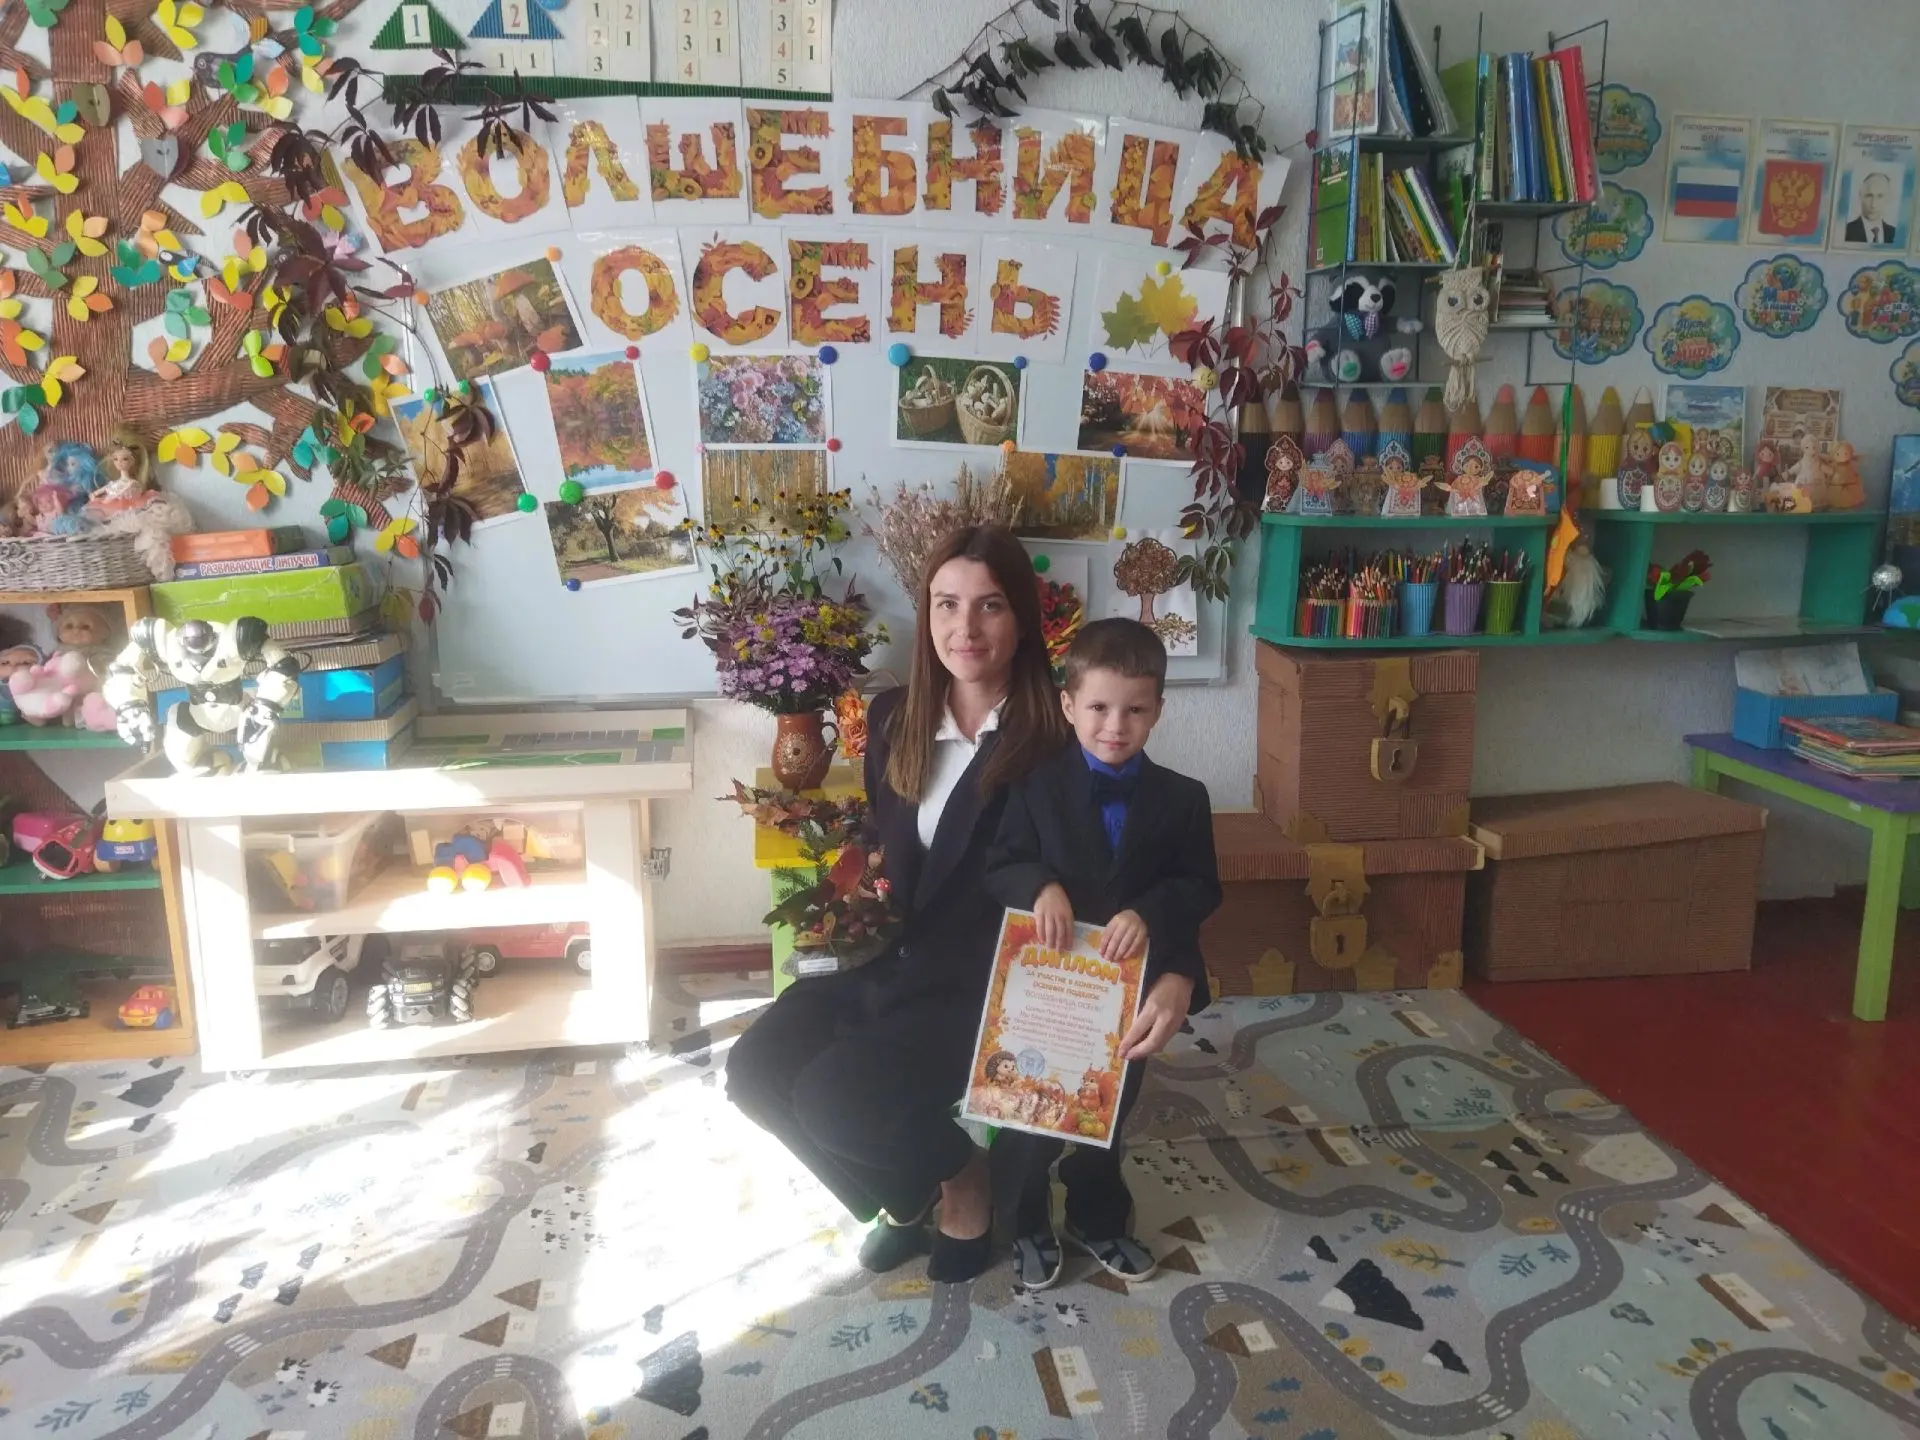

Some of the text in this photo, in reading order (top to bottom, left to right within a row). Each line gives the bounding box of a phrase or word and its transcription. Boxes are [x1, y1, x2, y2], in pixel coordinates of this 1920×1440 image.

[509, 4, 522, 28] 2
[625, 4, 634, 20] 2
[682, 7, 723, 26] 2 2
[776, 14, 817, 34] 3 2
[592, 29, 632, 47] 2 1
[682, 35, 723, 53] 3 1
[776, 41, 816, 61] 4 1
[496, 52, 538, 69] 1 1
[593, 56, 603, 73] 3
[682, 61, 694, 78] 4
[776, 68, 788, 84] 5
[1857, 132, 1909, 144] ПРЕЗИДЕНТ
[342, 108, 1264, 252] ВОЛШЕБНИЦА
[590, 236, 1061, 344] ОСЕНЬ
[200, 558, 274, 576] РАЗВИВАЮЩИЕ
[275, 553, 319, 570] ЛИПУЧКИ
[1021, 946, 1120, 985] ДИПЛОМ
